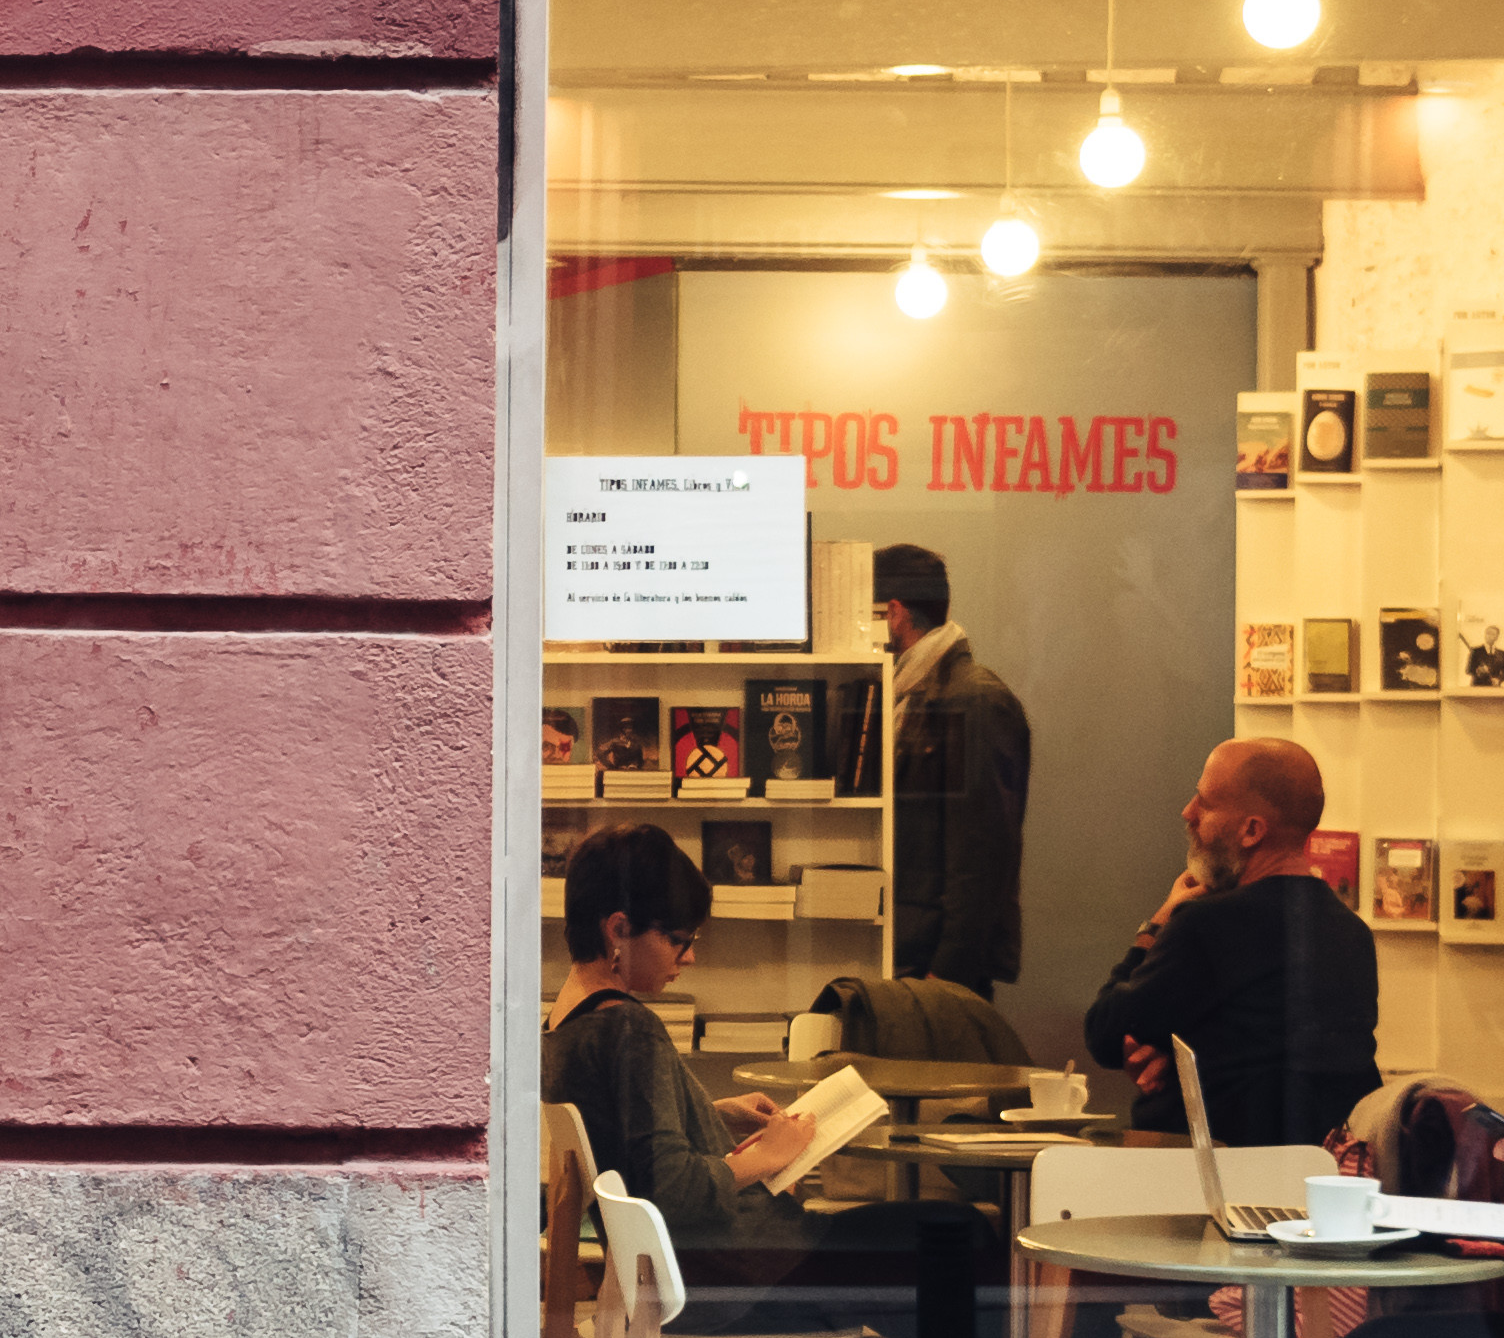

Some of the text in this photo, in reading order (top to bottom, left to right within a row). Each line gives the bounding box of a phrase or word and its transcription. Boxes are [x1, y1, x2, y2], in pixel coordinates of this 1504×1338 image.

[926, 412, 1178, 494] INFAMES
[600, 477, 628, 491] TIPOS
[567, 511, 606, 523] HORARIO
[761, 692, 811, 708] LA HORDA
